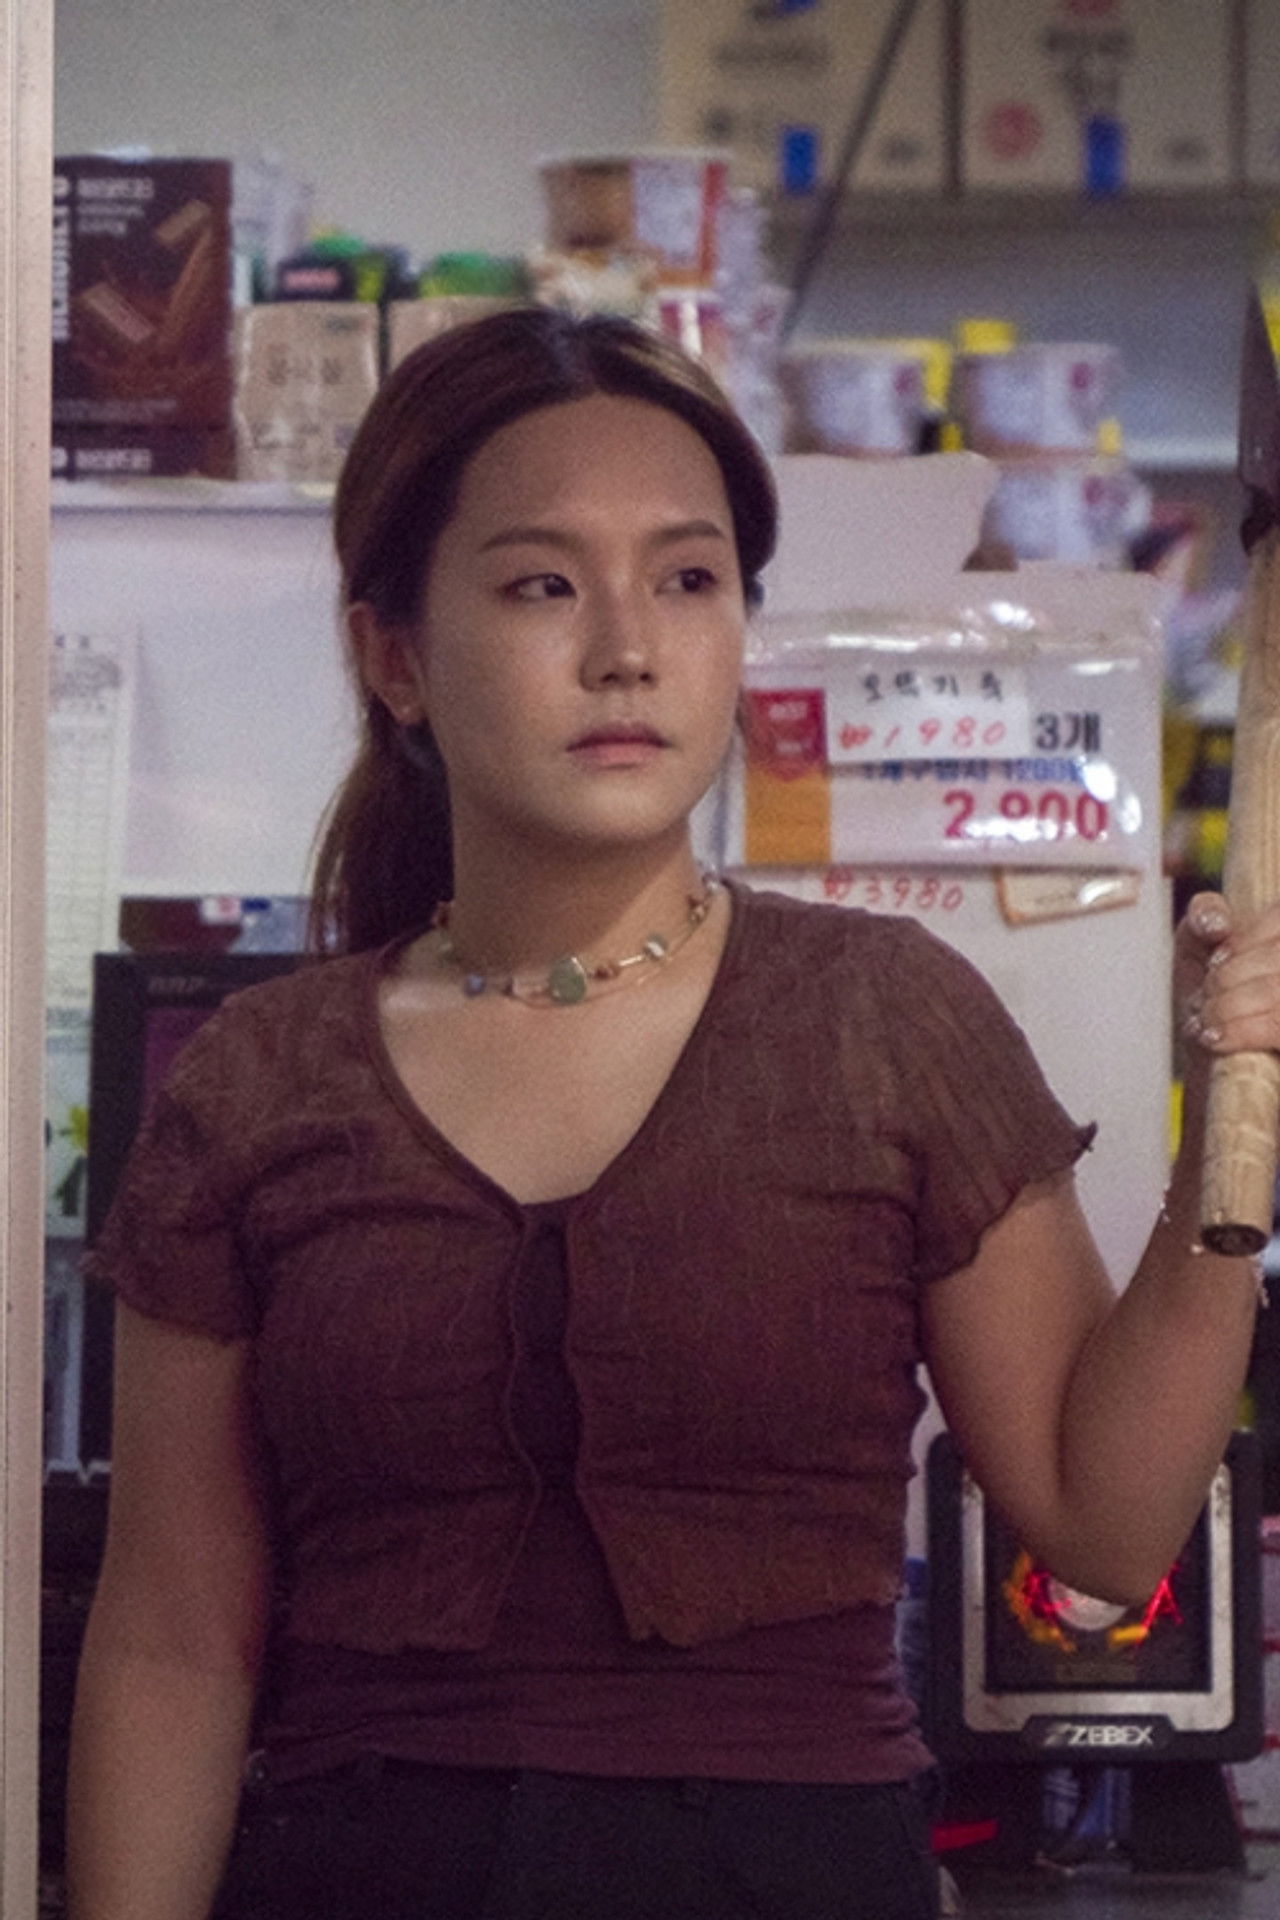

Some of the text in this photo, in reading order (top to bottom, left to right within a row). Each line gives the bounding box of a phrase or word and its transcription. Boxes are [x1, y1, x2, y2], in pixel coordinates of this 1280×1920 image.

[1035, 712, 1101, 752] 3개
[943, 790, 1108, 841] 2900
[1065, 1723, 1153, 1746] ZEBEX
